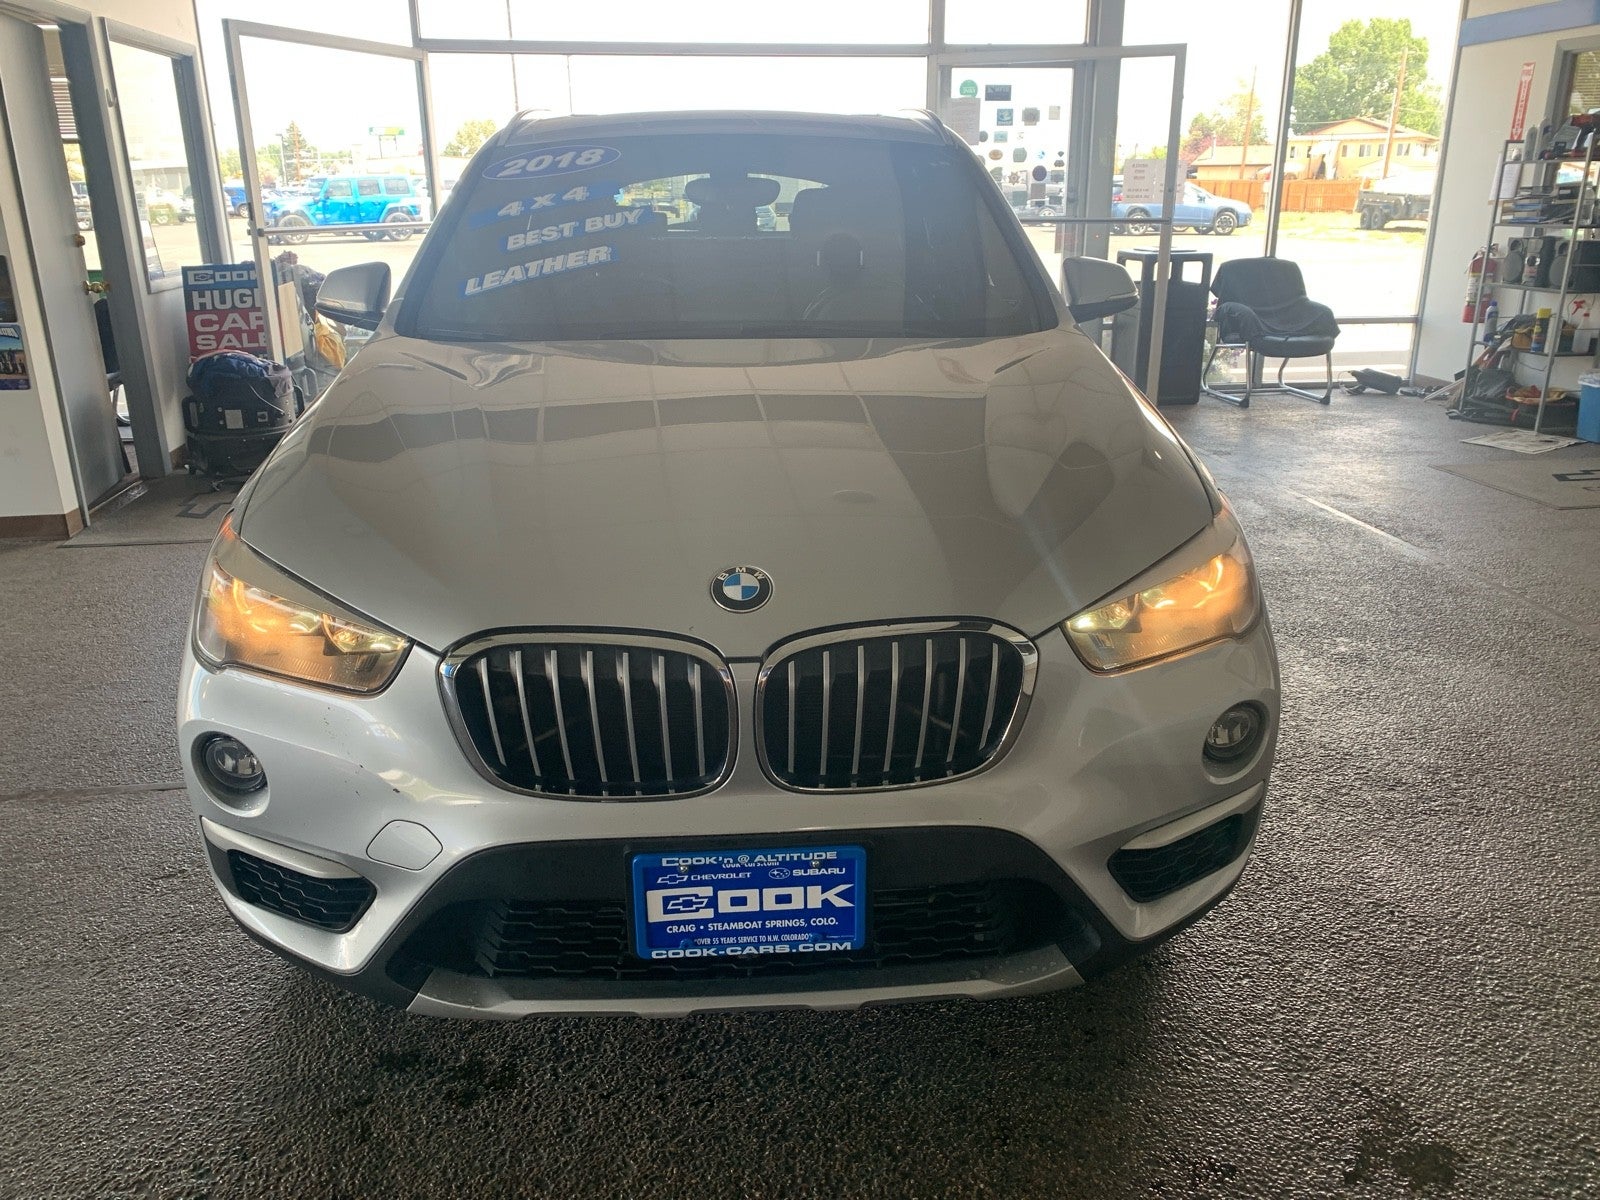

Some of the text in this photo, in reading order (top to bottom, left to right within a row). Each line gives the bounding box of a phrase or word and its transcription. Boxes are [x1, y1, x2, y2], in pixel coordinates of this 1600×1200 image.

[496, 148, 605, 178] 2018
[497, 200, 524, 217] 4
[562, 185, 590, 201] 4
[507, 208, 644, 250] BEST BUY
[464, 245, 612, 296] LEATHER
[717, 566, 765, 580] BMW
[738, 855, 750, 864] @
[753, 851, 837, 862] ALTITUDE
[691, 872, 752, 881] CHEVROLET
[792, 867, 846, 877] SUBARU
[646, 884, 855, 923] COOK
[666, 916, 839, 934] CRAIG STEAMBOAT SPRINGS, COLO.
[712, 937, 719, 945] 55
[720, 936, 737, 944] YEARS
[737, 935, 758, 944] SERVICE
[651, 942, 852, 959] COOK-CARS.COM
